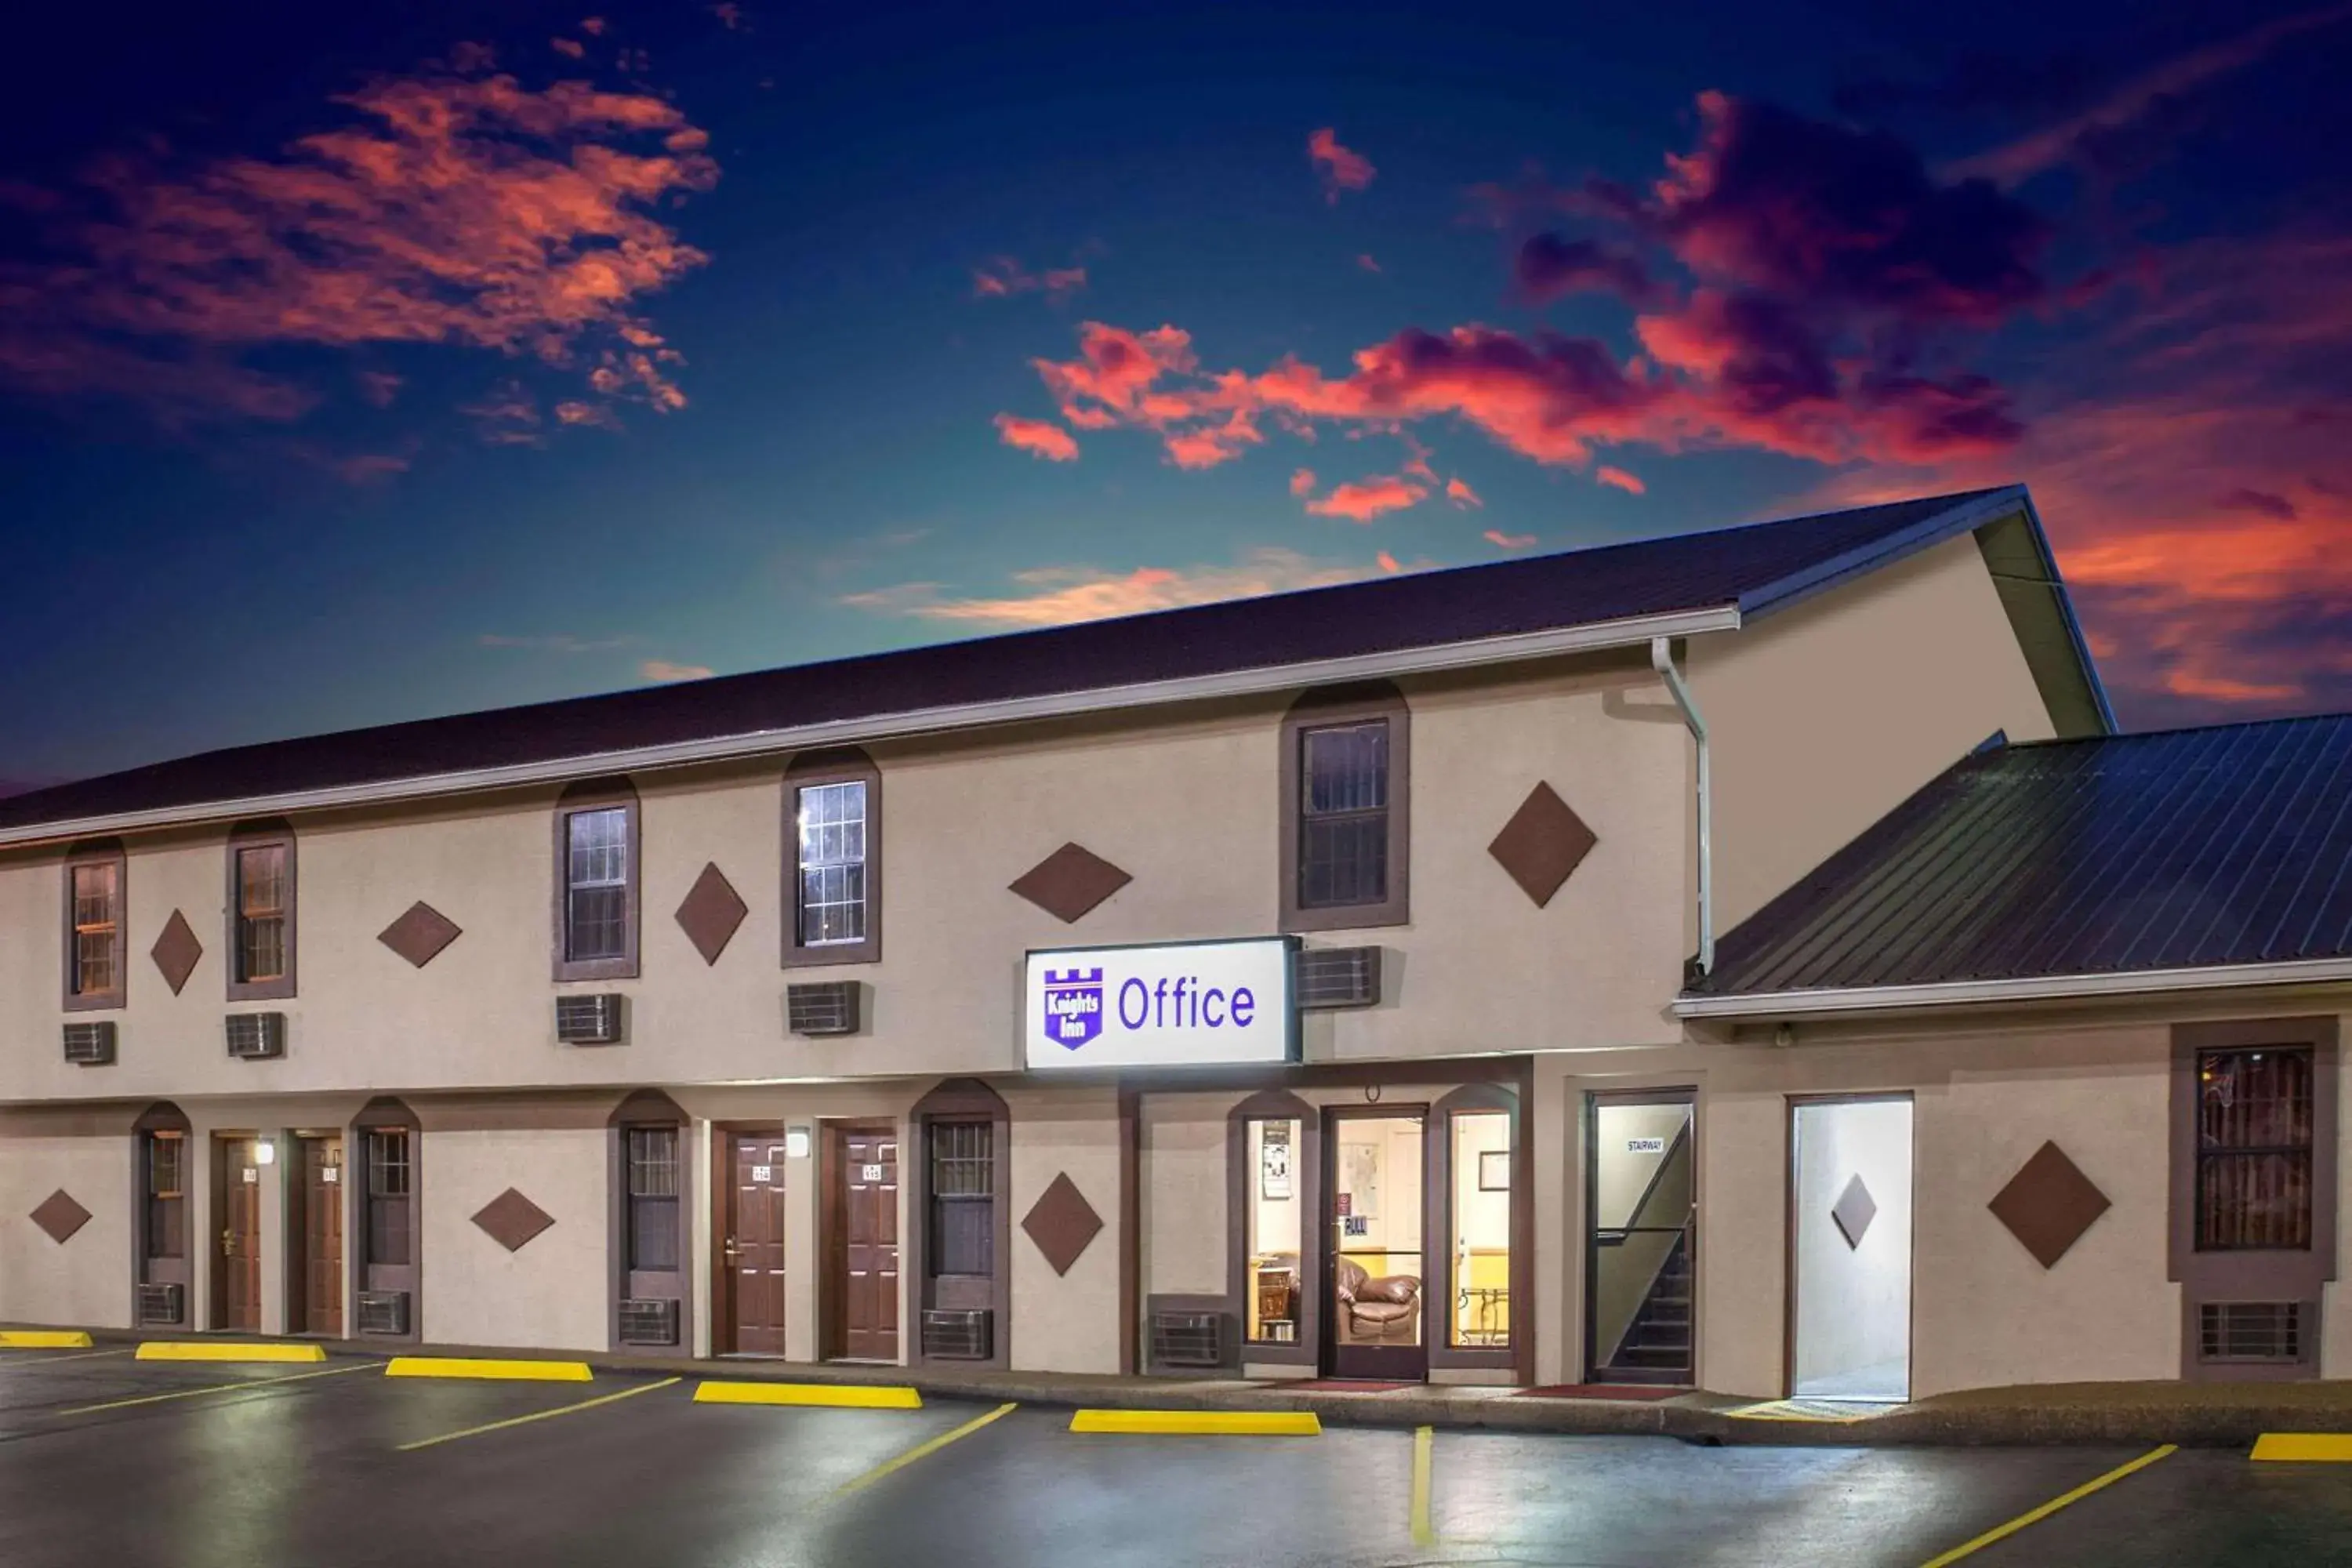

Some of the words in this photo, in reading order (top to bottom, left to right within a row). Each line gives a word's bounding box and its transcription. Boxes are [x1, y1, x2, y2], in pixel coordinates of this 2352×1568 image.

[1048, 992, 1098, 1019] Knights
[1119, 977, 1254, 1029] Office
[1060, 1016, 1086, 1038] Inn
[1628, 1141, 1661, 1152] STAIRWAY
